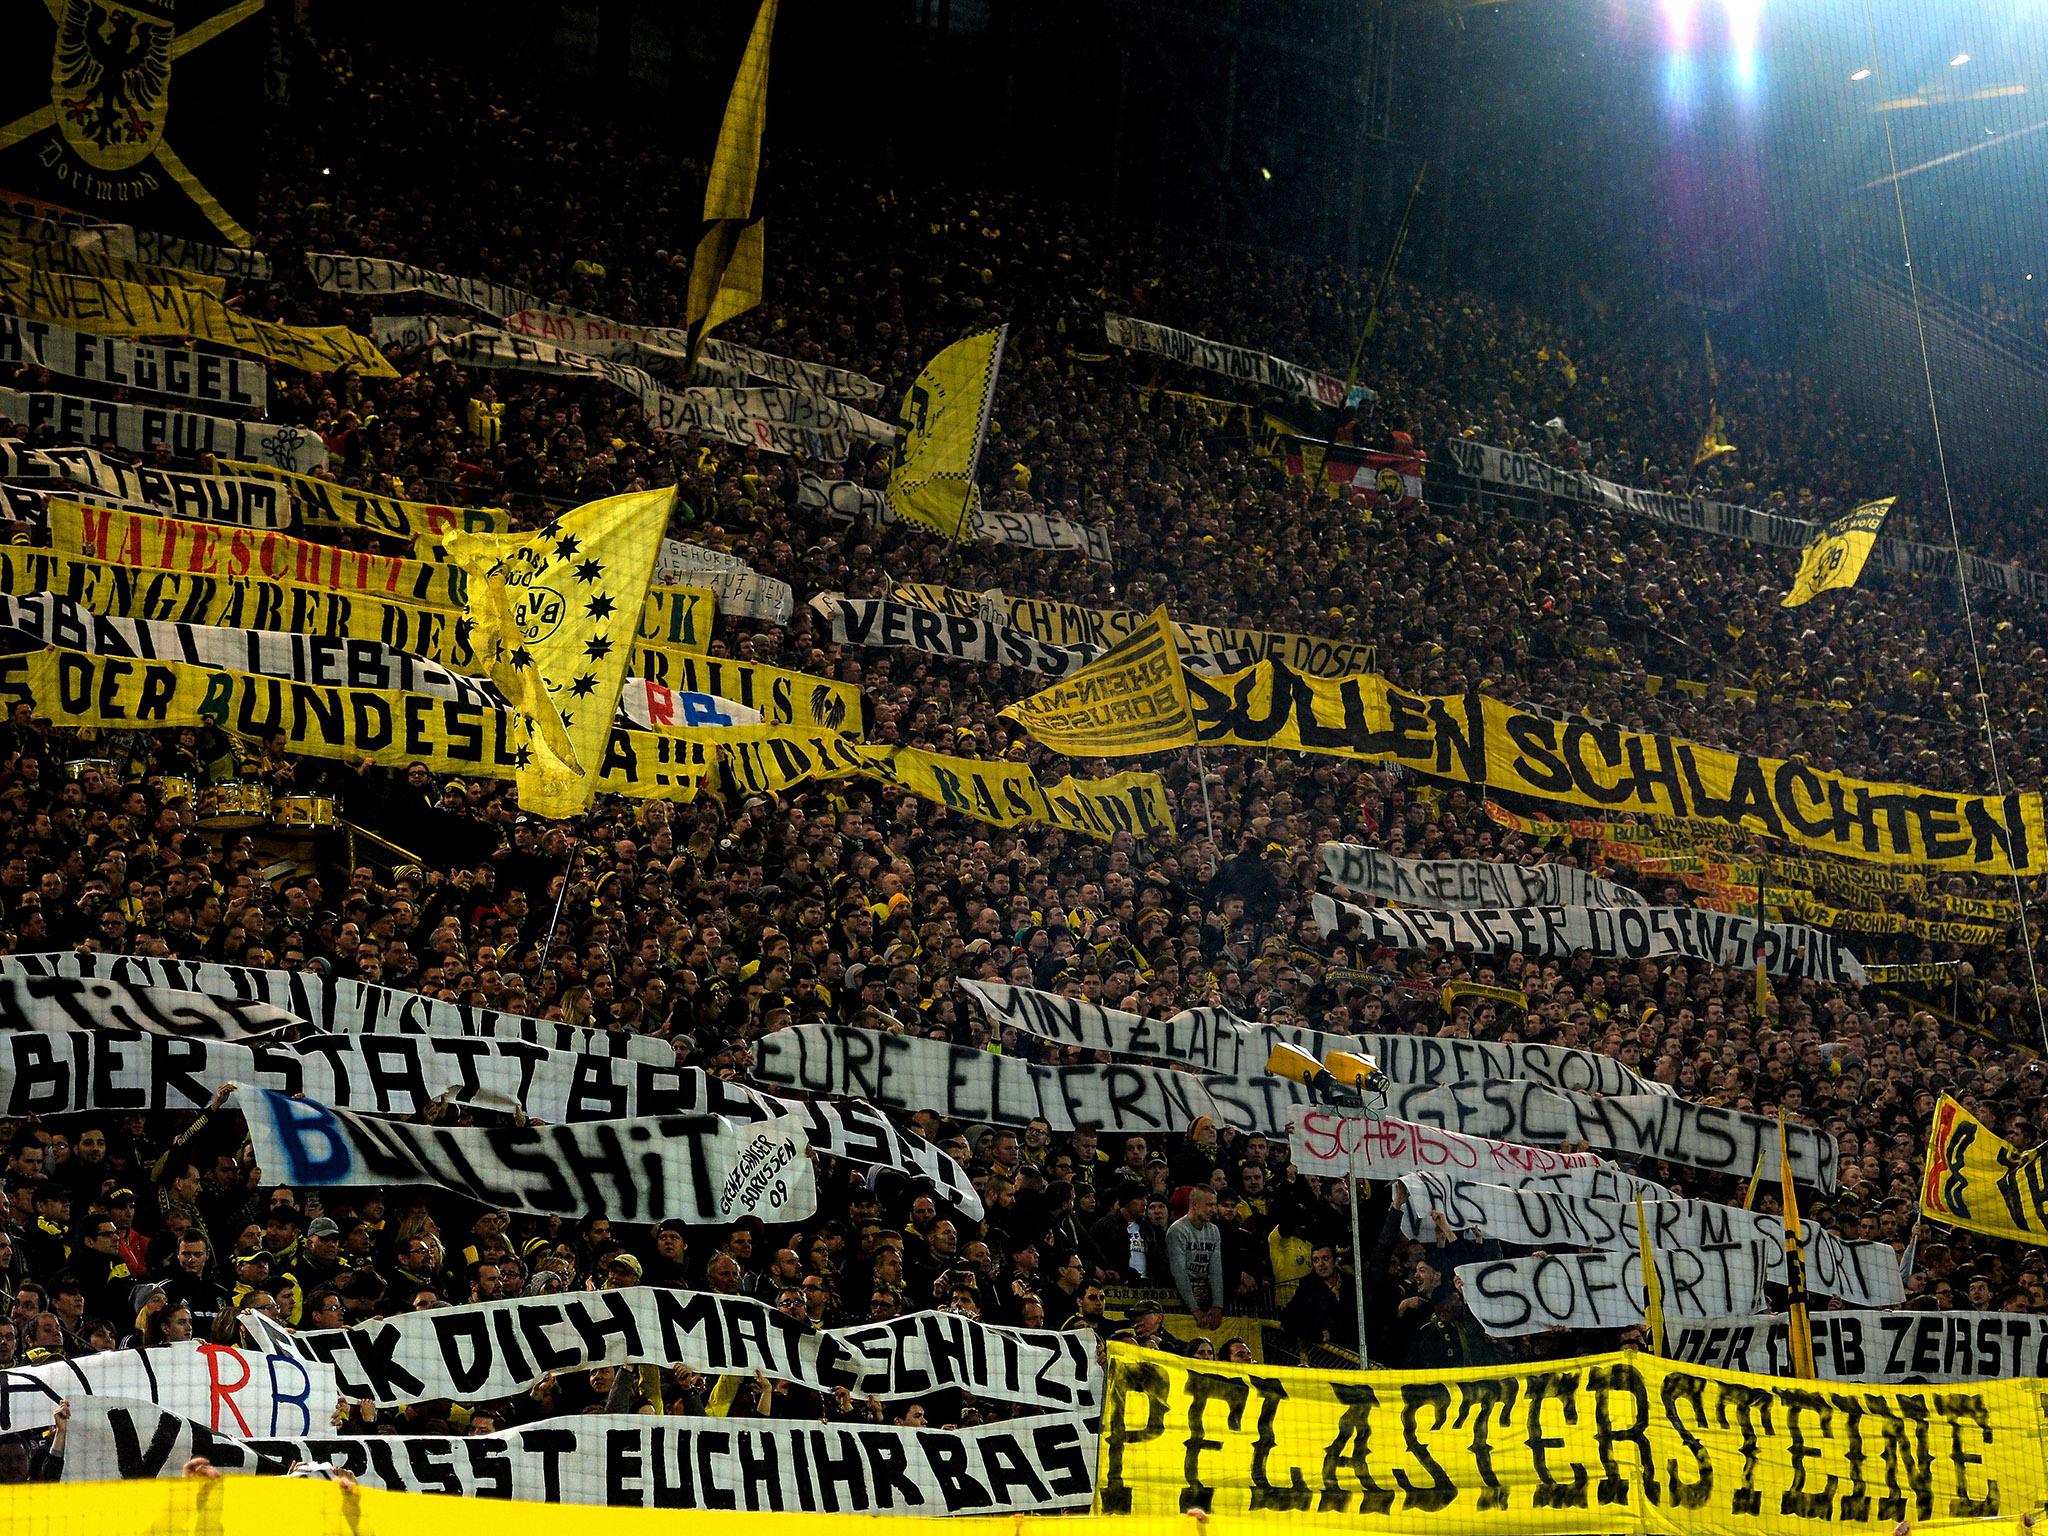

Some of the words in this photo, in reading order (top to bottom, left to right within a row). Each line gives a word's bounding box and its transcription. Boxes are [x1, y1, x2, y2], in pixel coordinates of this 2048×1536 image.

[38, 137, 160, 202] Dortmund
[315, 256, 374, 292] DER
[146, 285, 218, 338] MIT
[75, 338, 252, 405] FLÜGEL
[143, 408, 258, 463] BULL
[659, 395, 725, 435] BALL
[380, 603, 474, 668] DES
[838, 598, 1100, 676] VERPISST
[1060, 601, 1113, 650] MIR
[1294, 637, 1376, 679] DOSEN
[60, 652, 177, 720] DER
[1183, 659, 1488, 785] BULLEN
[1506, 714, 2031, 870] SCHLACHTEN
[1416, 861, 1513, 909] GEGEN
[9, 1029, 214, 1118] BIER
[253, 1034, 549, 1114] STATT
[754, 1026, 909, 1101] EURE
[947, 1046, 1194, 1130] ELTERN
[1401, 1079, 1837, 1195] GESCHWISTER
[1304, 1111, 1477, 1169] SCHEISS
[740, 1137, 797, 1213] BORUSSEN
[769, 1181, 790, 1210] 09
[431, 1290, 643, 1393] DICH
[606, 1428, 786, 1511] EUCH
[790, 1429, 924, 1510] IHR
[1101, 1359, 2001, 1522] PFLASTERSTEINE
